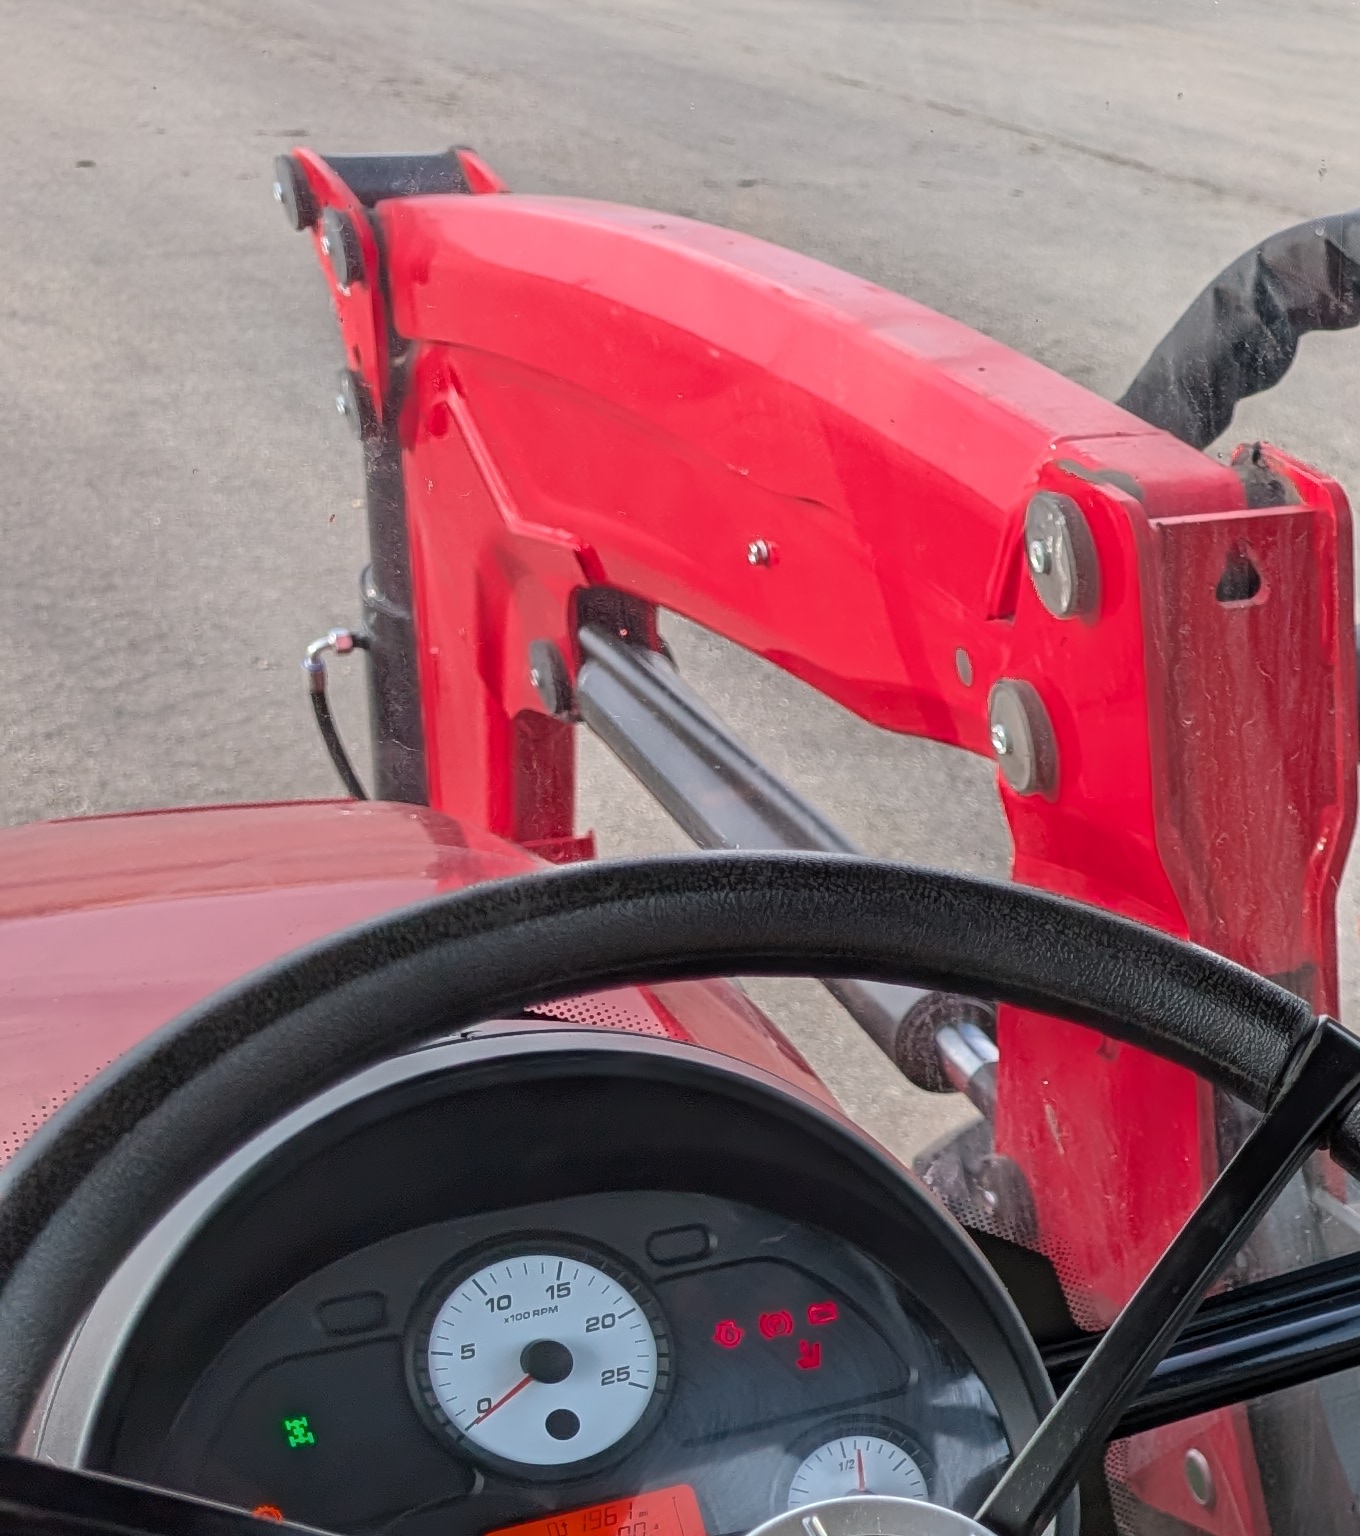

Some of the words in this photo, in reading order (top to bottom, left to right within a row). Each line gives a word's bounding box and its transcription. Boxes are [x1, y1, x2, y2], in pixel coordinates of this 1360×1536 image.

[545, 1281, 571, 1300] 15
[485, 1294, 512, 1313] 10
[503, 1311, 531, 1324] x100
[532, 1305, 559, 1318] RPM
[585, 1313, 616, 1333] 20
[460, 1342, 476, 1360] 5
[601, 1366, 630, 1386] 25
[476, 1397, 492, 1414] 0
[838, 1458, 855, 1472] 1/2
